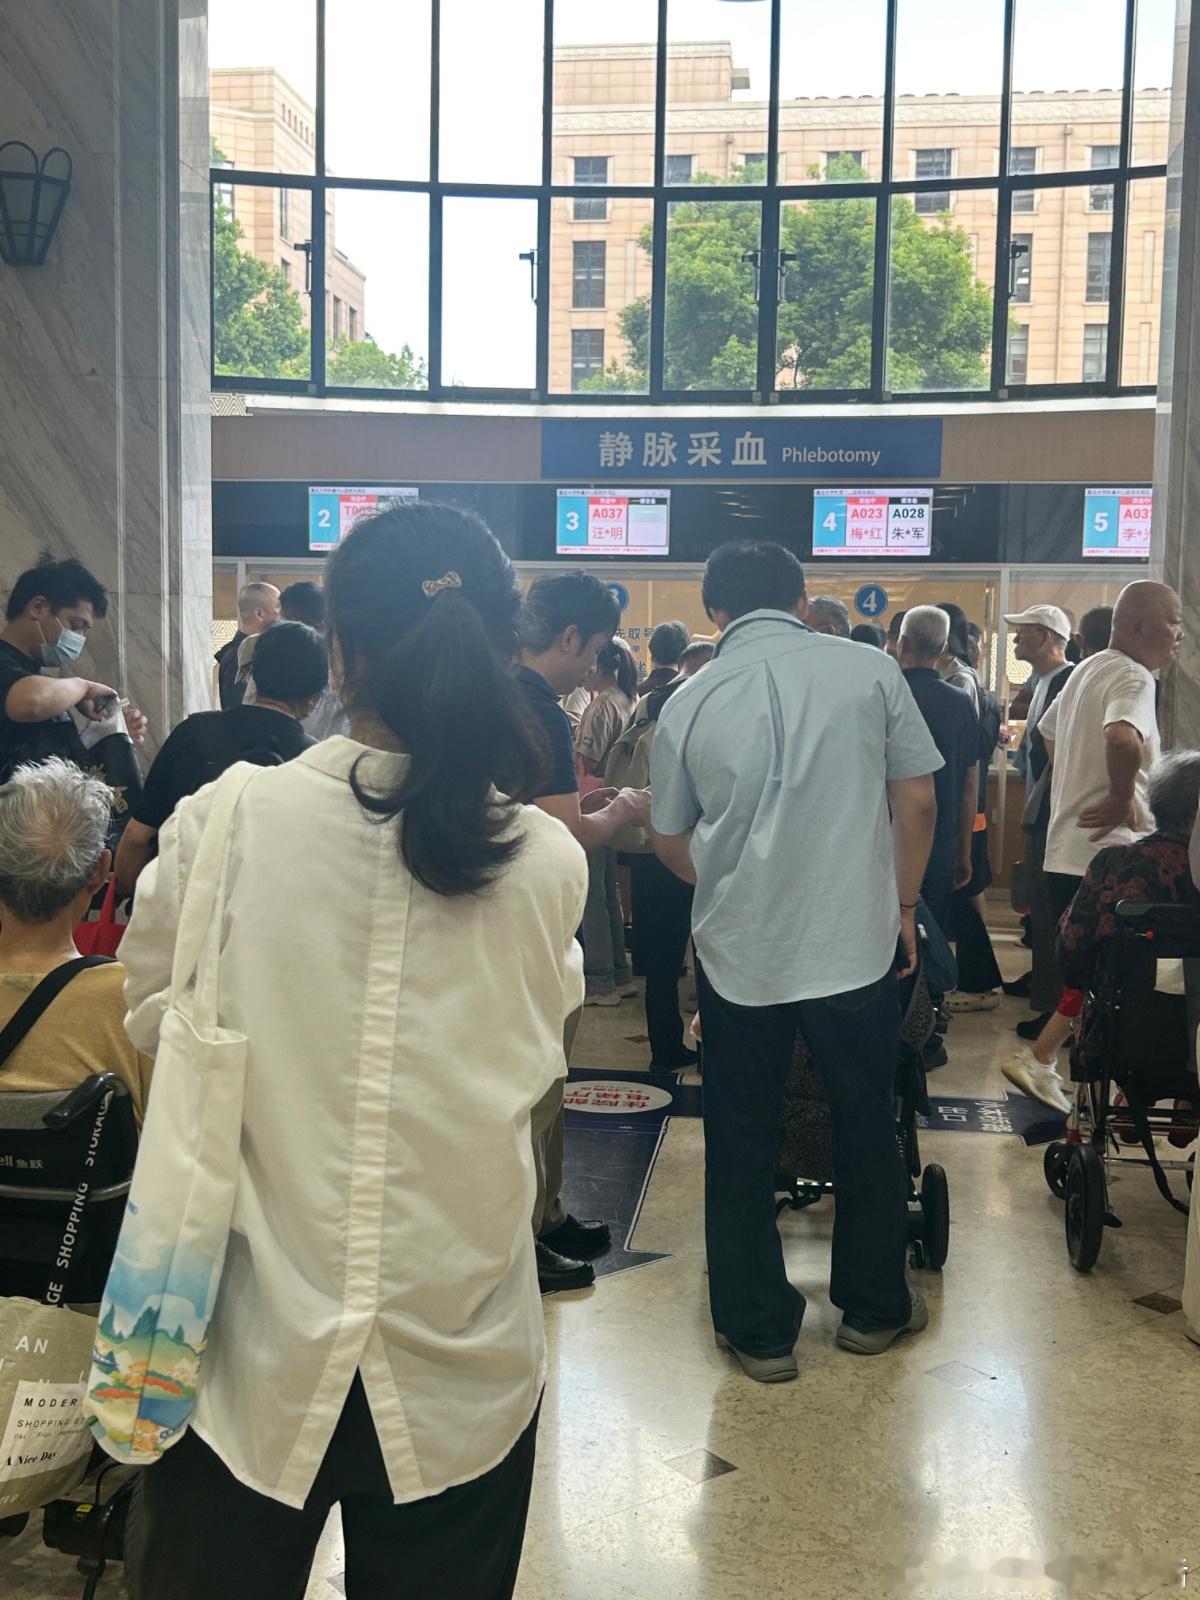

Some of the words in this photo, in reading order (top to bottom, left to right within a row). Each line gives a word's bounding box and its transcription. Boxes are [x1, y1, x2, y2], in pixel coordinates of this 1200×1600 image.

[598, 431, 767, 467] 静脉采血
[781, 447, 880, 466] Phlebotomy
[317, 509, 331, 528] 2
[565, 511, 579, 531] 3
[592, 508, 623, 519] A037
[822, 512, 837, 531] 4
[851, 508, 883, 519] A023
[892, 508, 925, 519] A028
[1093, 512, 1109, 532] 5
[1123, 508, 1152, 519] A03
[862, 590, 878, 612] 4
[937, 1106, 969, 1122] 出口
[56, 1181, 89, 1269] SHOPPING
[17, 1418, 70, 1429] SHOPPING
